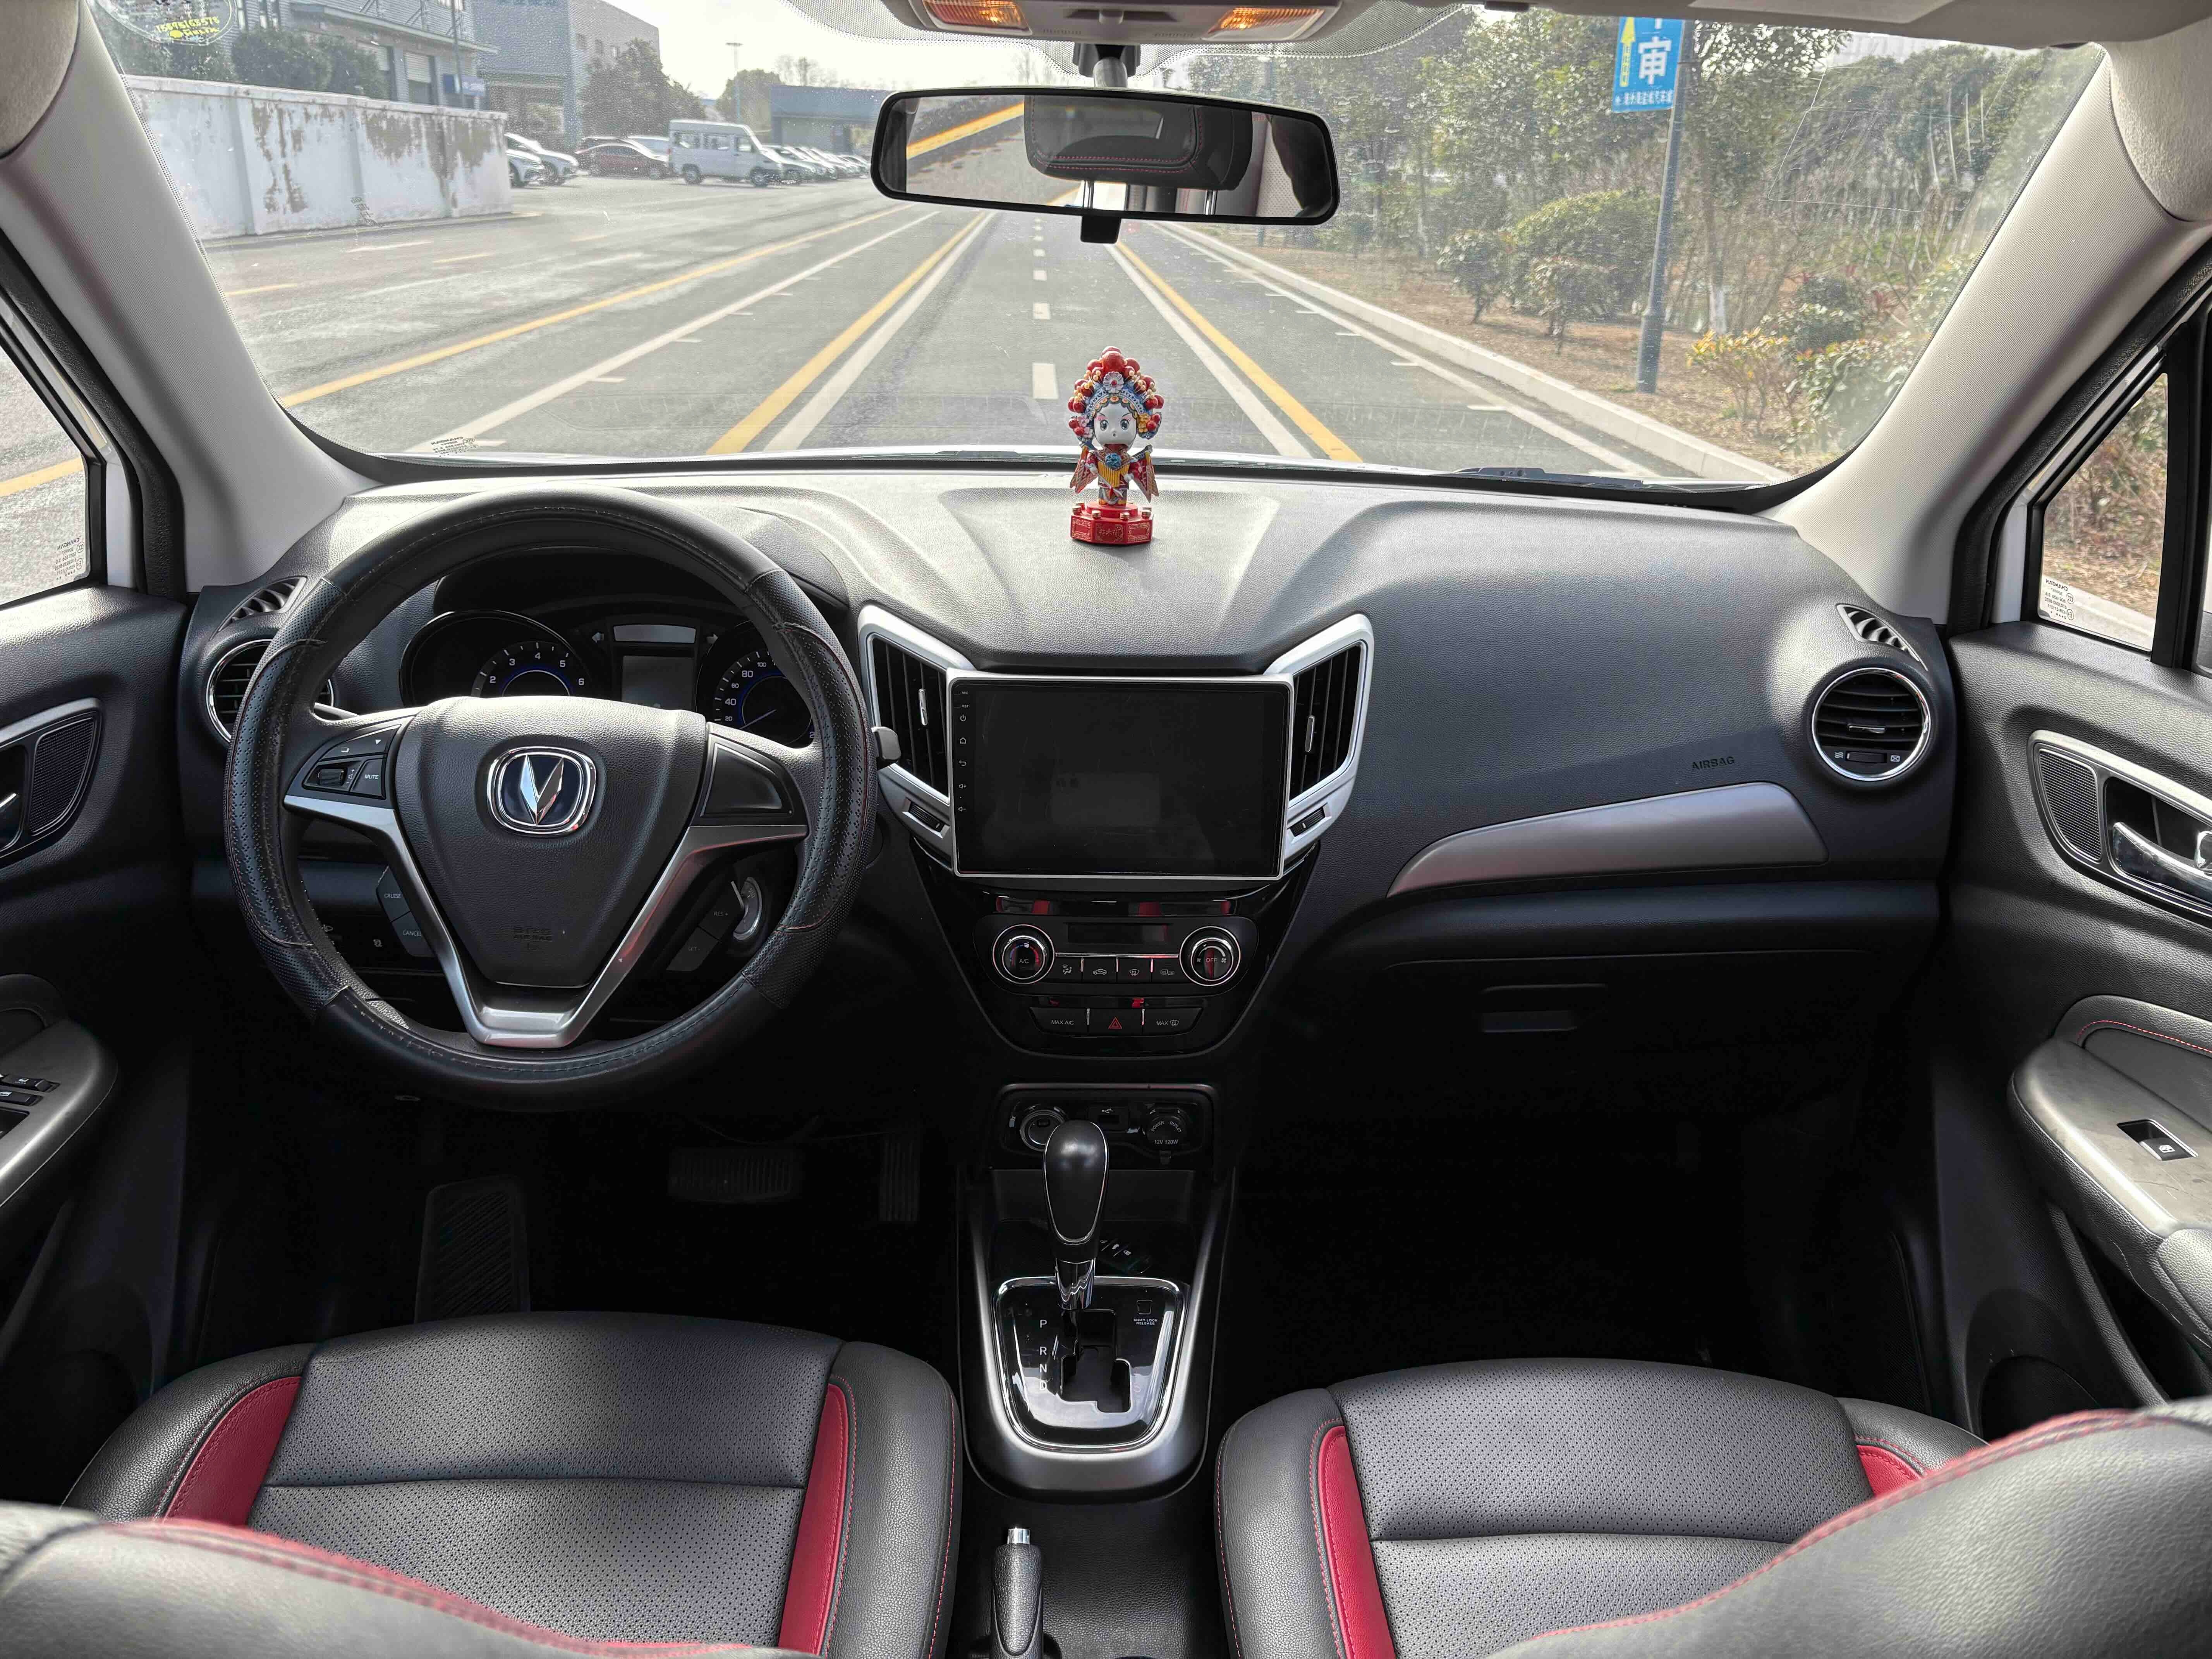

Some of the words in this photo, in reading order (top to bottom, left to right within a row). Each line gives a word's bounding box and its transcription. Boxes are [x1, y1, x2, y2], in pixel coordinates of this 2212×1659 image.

[1637, 19, 1672, 84] 审
[1692, 756, 1735, 769] AIRBAG
[1151, 1121, 1165, 1132] POWER
[1169, 1121, 1182, 1132] OUTLET
[1040, 1319, 1047, 1328] P
[1040, 1346, 1047, 1355] R
[1039, 1364, 1047, 1373] N
[1039, 1381, 1047, 1391] D
